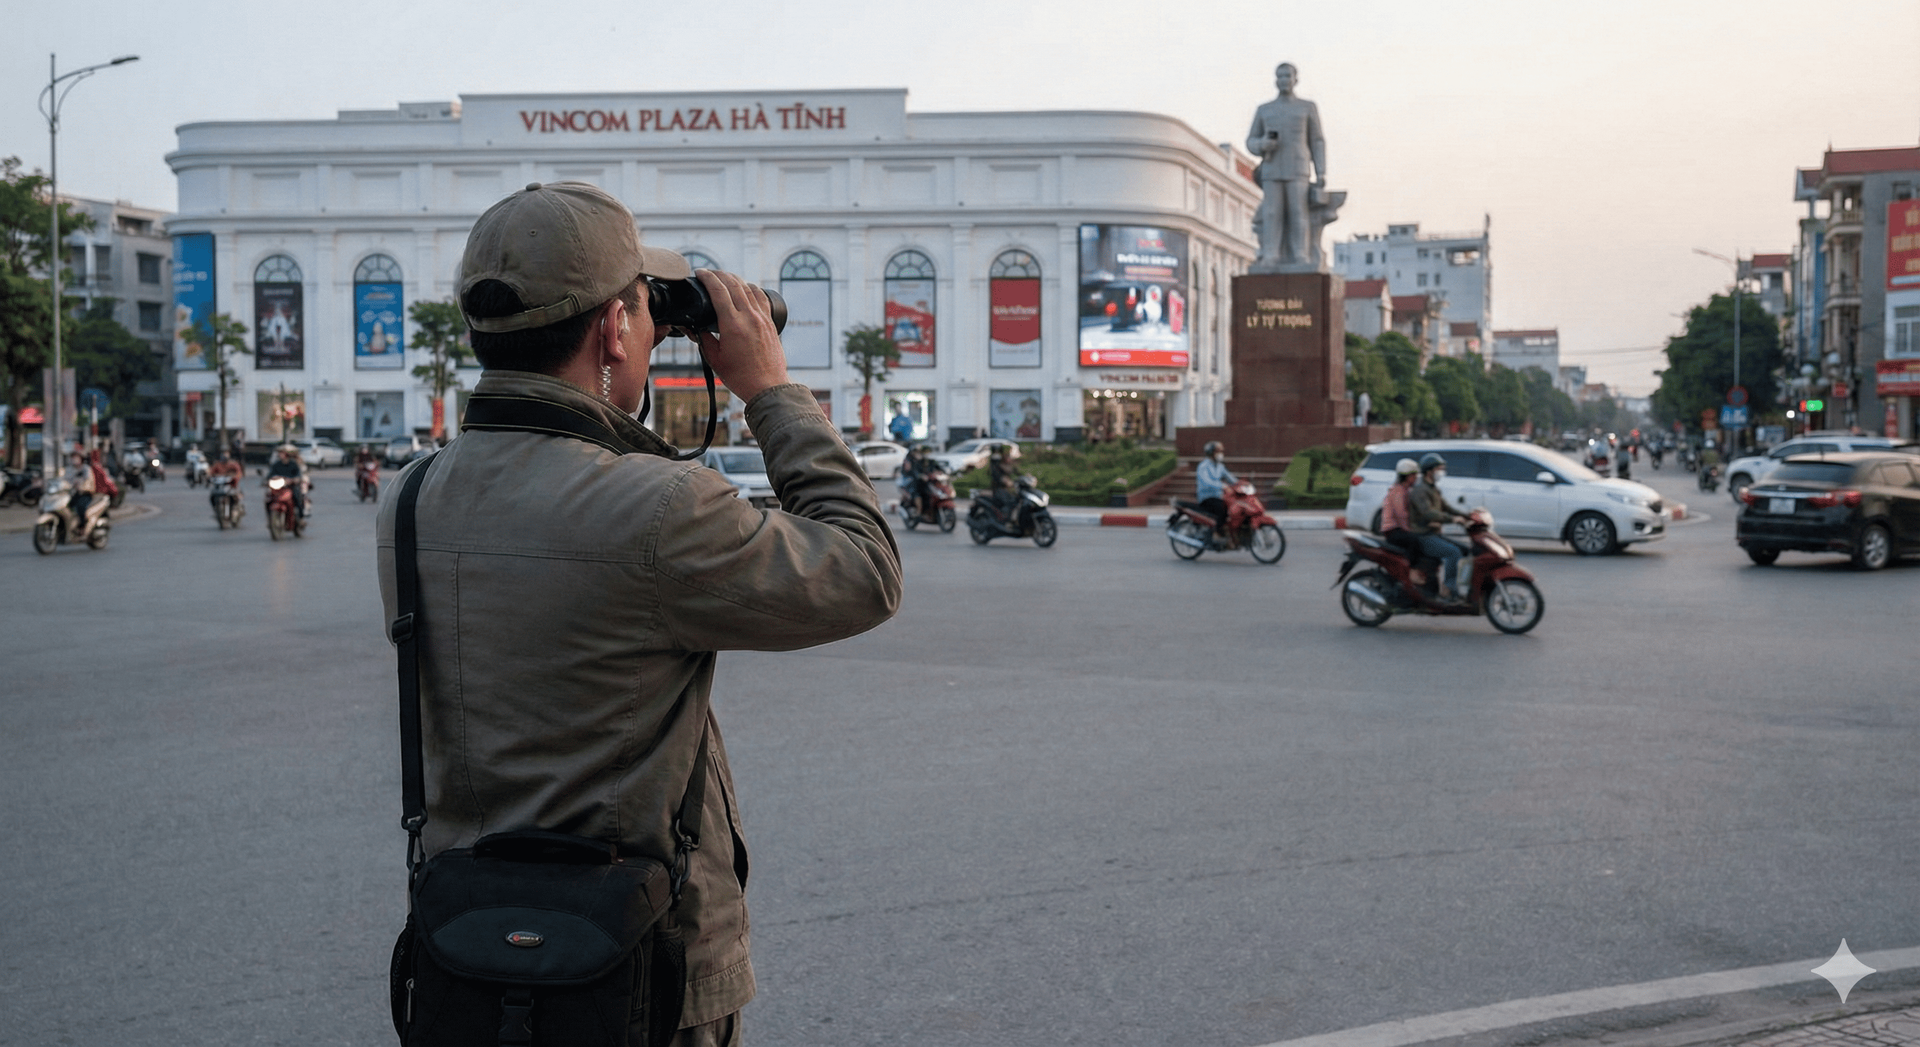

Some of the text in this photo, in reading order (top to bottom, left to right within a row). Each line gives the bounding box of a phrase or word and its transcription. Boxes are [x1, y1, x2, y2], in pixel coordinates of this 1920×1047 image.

[520, 102, 846, 132] VINCOM PLAZA HÀ TĨNH
[1277, 313, 1312, 330] TRỌNG
